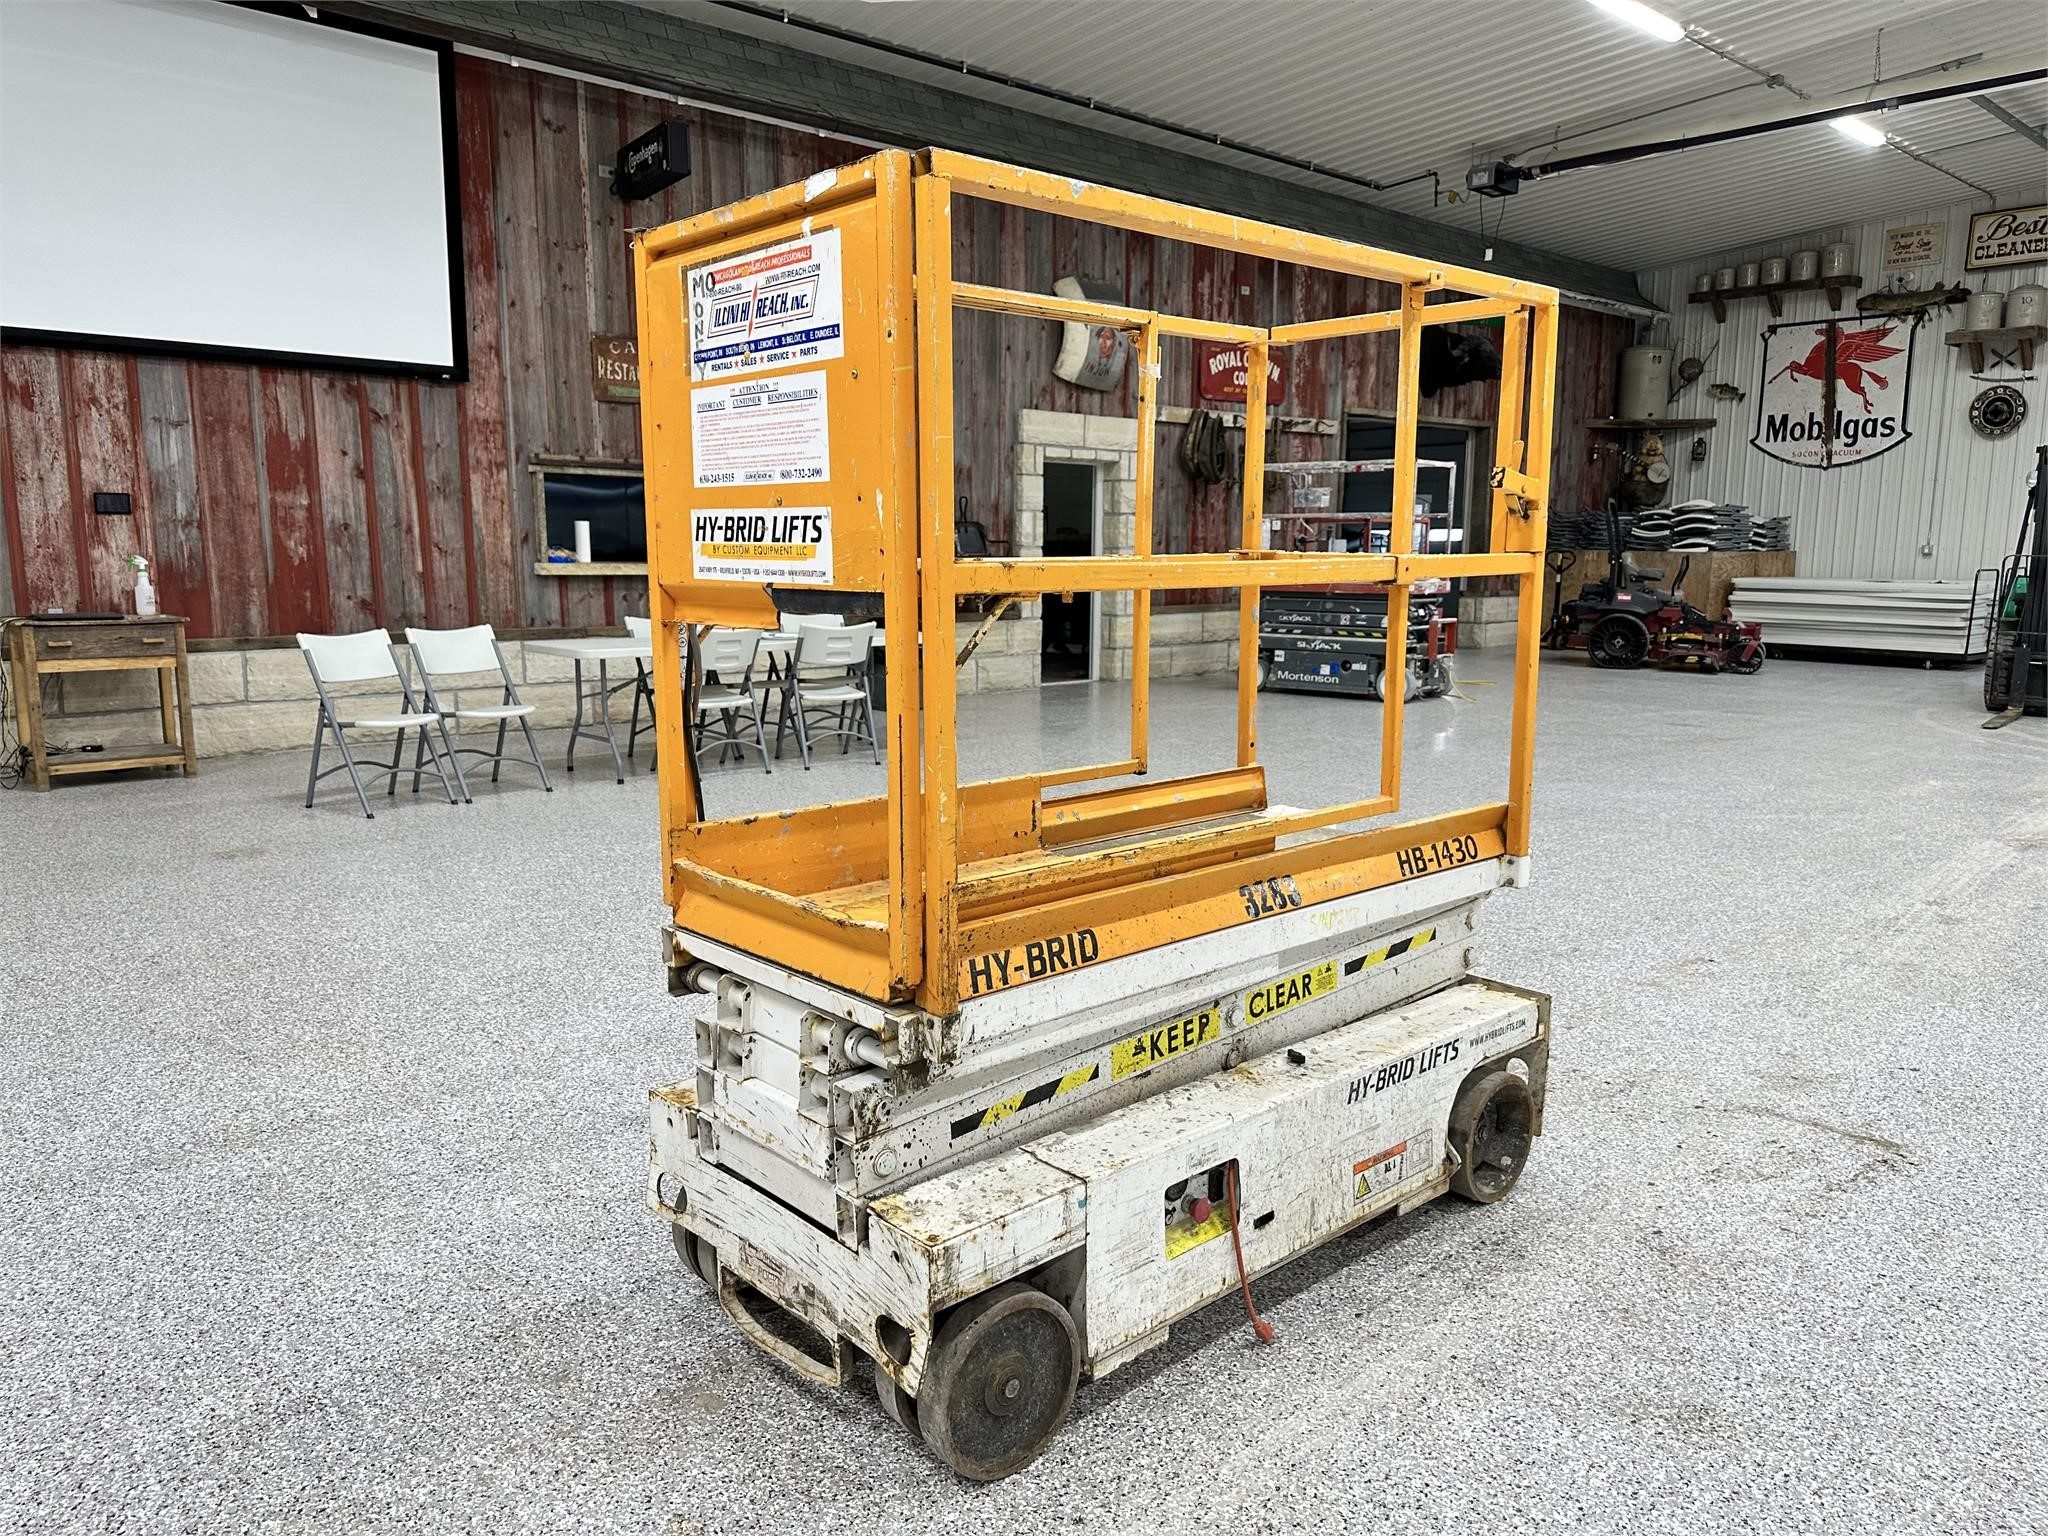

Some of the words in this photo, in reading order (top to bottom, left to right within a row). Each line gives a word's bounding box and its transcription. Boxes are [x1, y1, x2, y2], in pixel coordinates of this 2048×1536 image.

[628, 142, 658, 174] Copenhagen
[1977, 214, 2048, 243] Best
[740, 300, 750, 322] HI
[755, 292, 789, 319] REACH,
[790, 294, 808, 311] INC.
[598, 356, 639, 381] RESTA
[712, 361, 733, 372] RENTALS
[741, 357, 757, 367] SALES
[767, 351, 789, 362] SERVICE
[800, 346, 818, 357] PARTS
[1208, 350, 1242, 375] ROYAL
[1244, 351, 1280, 382] CWN
[697, 400, 725, 411] IMPORTANT
[732, 396, 761, 407] CUSTOMER
[768, 388, 818, 401] RESPONSIBILITIES
[739, 383, 770, 394] ATTENTION
[1765, 410, 1896, 447] Moblgas
[695, 515, 766, 543] HY-BRID
[771, 515, 822, 543] LIFTS
[713, 545, 720, 554] BY
[723, 545, 750, 555] CUSTOM
[754, 546, 793, 556] EQUIPMENT
[796, 546, 807, 556] LLC
[1277, 670, 1339, 684] Mortenson
[1396, 834, 1478, 877] HB-1430
[1238, 875, 1302, 919] 3283
[969, 928, 1099, 994] HY-BRID
[1150, 1014, 1210, 1061] KEEP
[1250, 973, 1312, 1018] CLEAR
[1347, 1057, 1414, 1105] HY-BRID
[1418, 1038, 1460, 1074] LIFTS
[1470, 1018, 1526, 1048] WWW.HYBRIDLIFTS.COM
